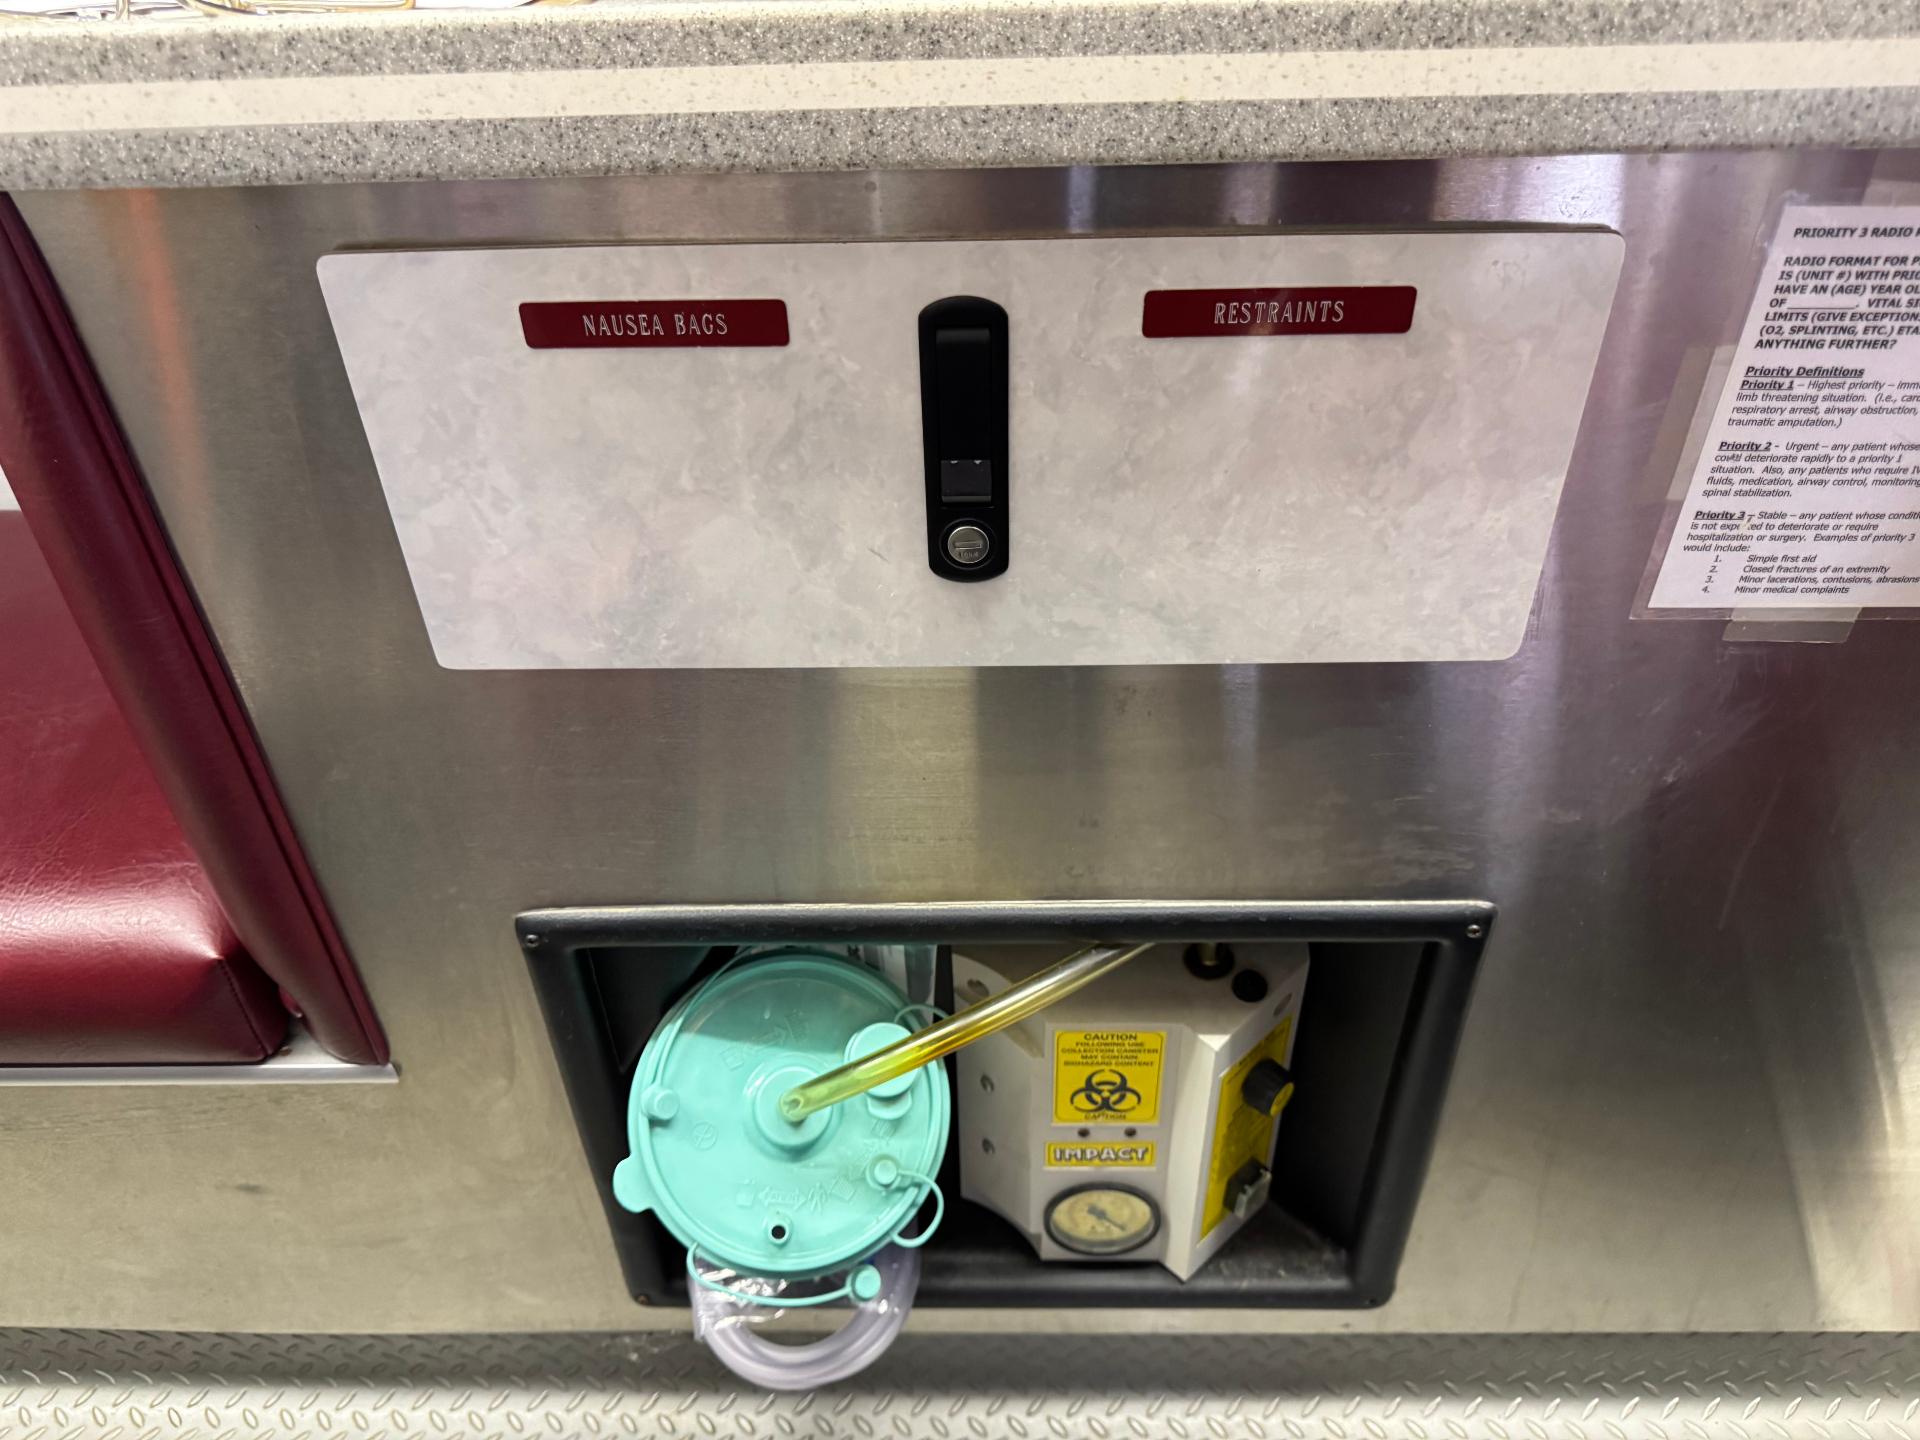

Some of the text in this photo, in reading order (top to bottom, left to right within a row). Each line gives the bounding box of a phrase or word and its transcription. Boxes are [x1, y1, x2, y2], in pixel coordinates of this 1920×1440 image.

[1794, 227, 1858, 238] PRIORITY
[1858, 227, 1868, 238] 3
[1870, 227, 1913, 238] RADIO
[1784, 256, 1826, 266] RADIO
[1828, 256, 1881, 266] FORMAT
[1883, 256, 1908, 266] FOR
[1778, 270, 1793, 280] IS
[1796, 270, 1834, 282] (UNIT
[1836, 270, 1851, 282] #)
[1855, 270, 1889, 280] WITH
[1774, 284, 1808, 294] HAVE
[1810, 284, 1828, 294] AN
[1831, 284, 1867, 296] (AGE)
[1870, 284, 1901, 294] YEAR
[1769, 298, 1787, 308] OF
[1868, 298, 1901, 308] VITAL
[1214, 300, 1344, 324] RESTRAINTS
[1764, 312, 1808, 322] LIMITS
[1811, 312, 1846, 324] (GIVE
[582, 312, 728, 336] NAUSEA BAGS
[1788, 325, 1858, 337] SPLINTING,
[1862, 325, 1893, 337] ETC.)
[1754, 339, 1897, 349] ANYTHING FURTHER?
[1744, 366, 1865, 378] Priority Definitions
[1740, 380, 1784, 390] Priority
[1786, 380, 1794, 390] 1
[1808, 381, 1845, 392] Highest
[1848, 381, 1885, 392] priority
[1736, 392, 1758, 402] limb
[1761, 392, 1818, 404] threatening
[1821, 392, 1867, 402] situation.
[1732, 405, 1918, 416] respiratory arrest, airway obstruction,
[1728, 417, 1842, 428] traumatic amputation.)
[1718, 442, 1762, 452] Priority
[1764, 442, 1772, 451] 2
[1785, 442, 1819, 452] Urgent
[1831, 444, 1848, 452] any
[1850, 442, 1887, 452] patient
[1890, 442, 1920, 451] whose
[1744, 454, 1798, 462] deteriorate
[1800, 454, 1834, 464] rapidly
[1858, 455, 1894, 464] priority
[1710, 465, 1754, 474] situation.
[1762, 465, 1784, 475] Also,
[1788, 467, 1807, 475] any
[1808, 466, 1848, 475] patients
[1874, 466, 1909, 476] require
[1706, 476, 1735, 486] fluids,
[1739, 477, 1794, 487] medication,
[1798, 478, 1828, 487] airway
[1830, 478, 1868, 487] control,
[1702, 488, 1792, 498] spinal stabilization.
[1693, 510, 1736, 520] Priority
[1737, 511, 1745, 520] 3
[1758, 511, 1787, 520] Stable
[1798, 513, 1817, 521] any
[1818, 512, 1853, 521] patient
[1690, 522, 1699, 530] is
[1777, 523, 1829, 531] deteriorate
[1845, 523, 1878, 532] require
[1686, 532, 1754, 542] hospitalization
[1768, 534, 1806, 543] surgery.
[1813, 533, 1858, 543] Examples
[1872, 533, 1907, 543] priority
[1714, 554, 1817, 564] 1. Simple first aid
[1743, 565, 1774, 573] Closed
[1776, 565, 1817, 573] fractures
[1819, 565, 1831, 573] of
[1846, 566, 1890, 574] extremity
[1767, 576, 1818, 584] lacerations,
[1822, 576, 1873, 584] contusions,
[1800, 586, 1850, 595] complaints
[1054, 1147, 1149, 1161] IMPACT
